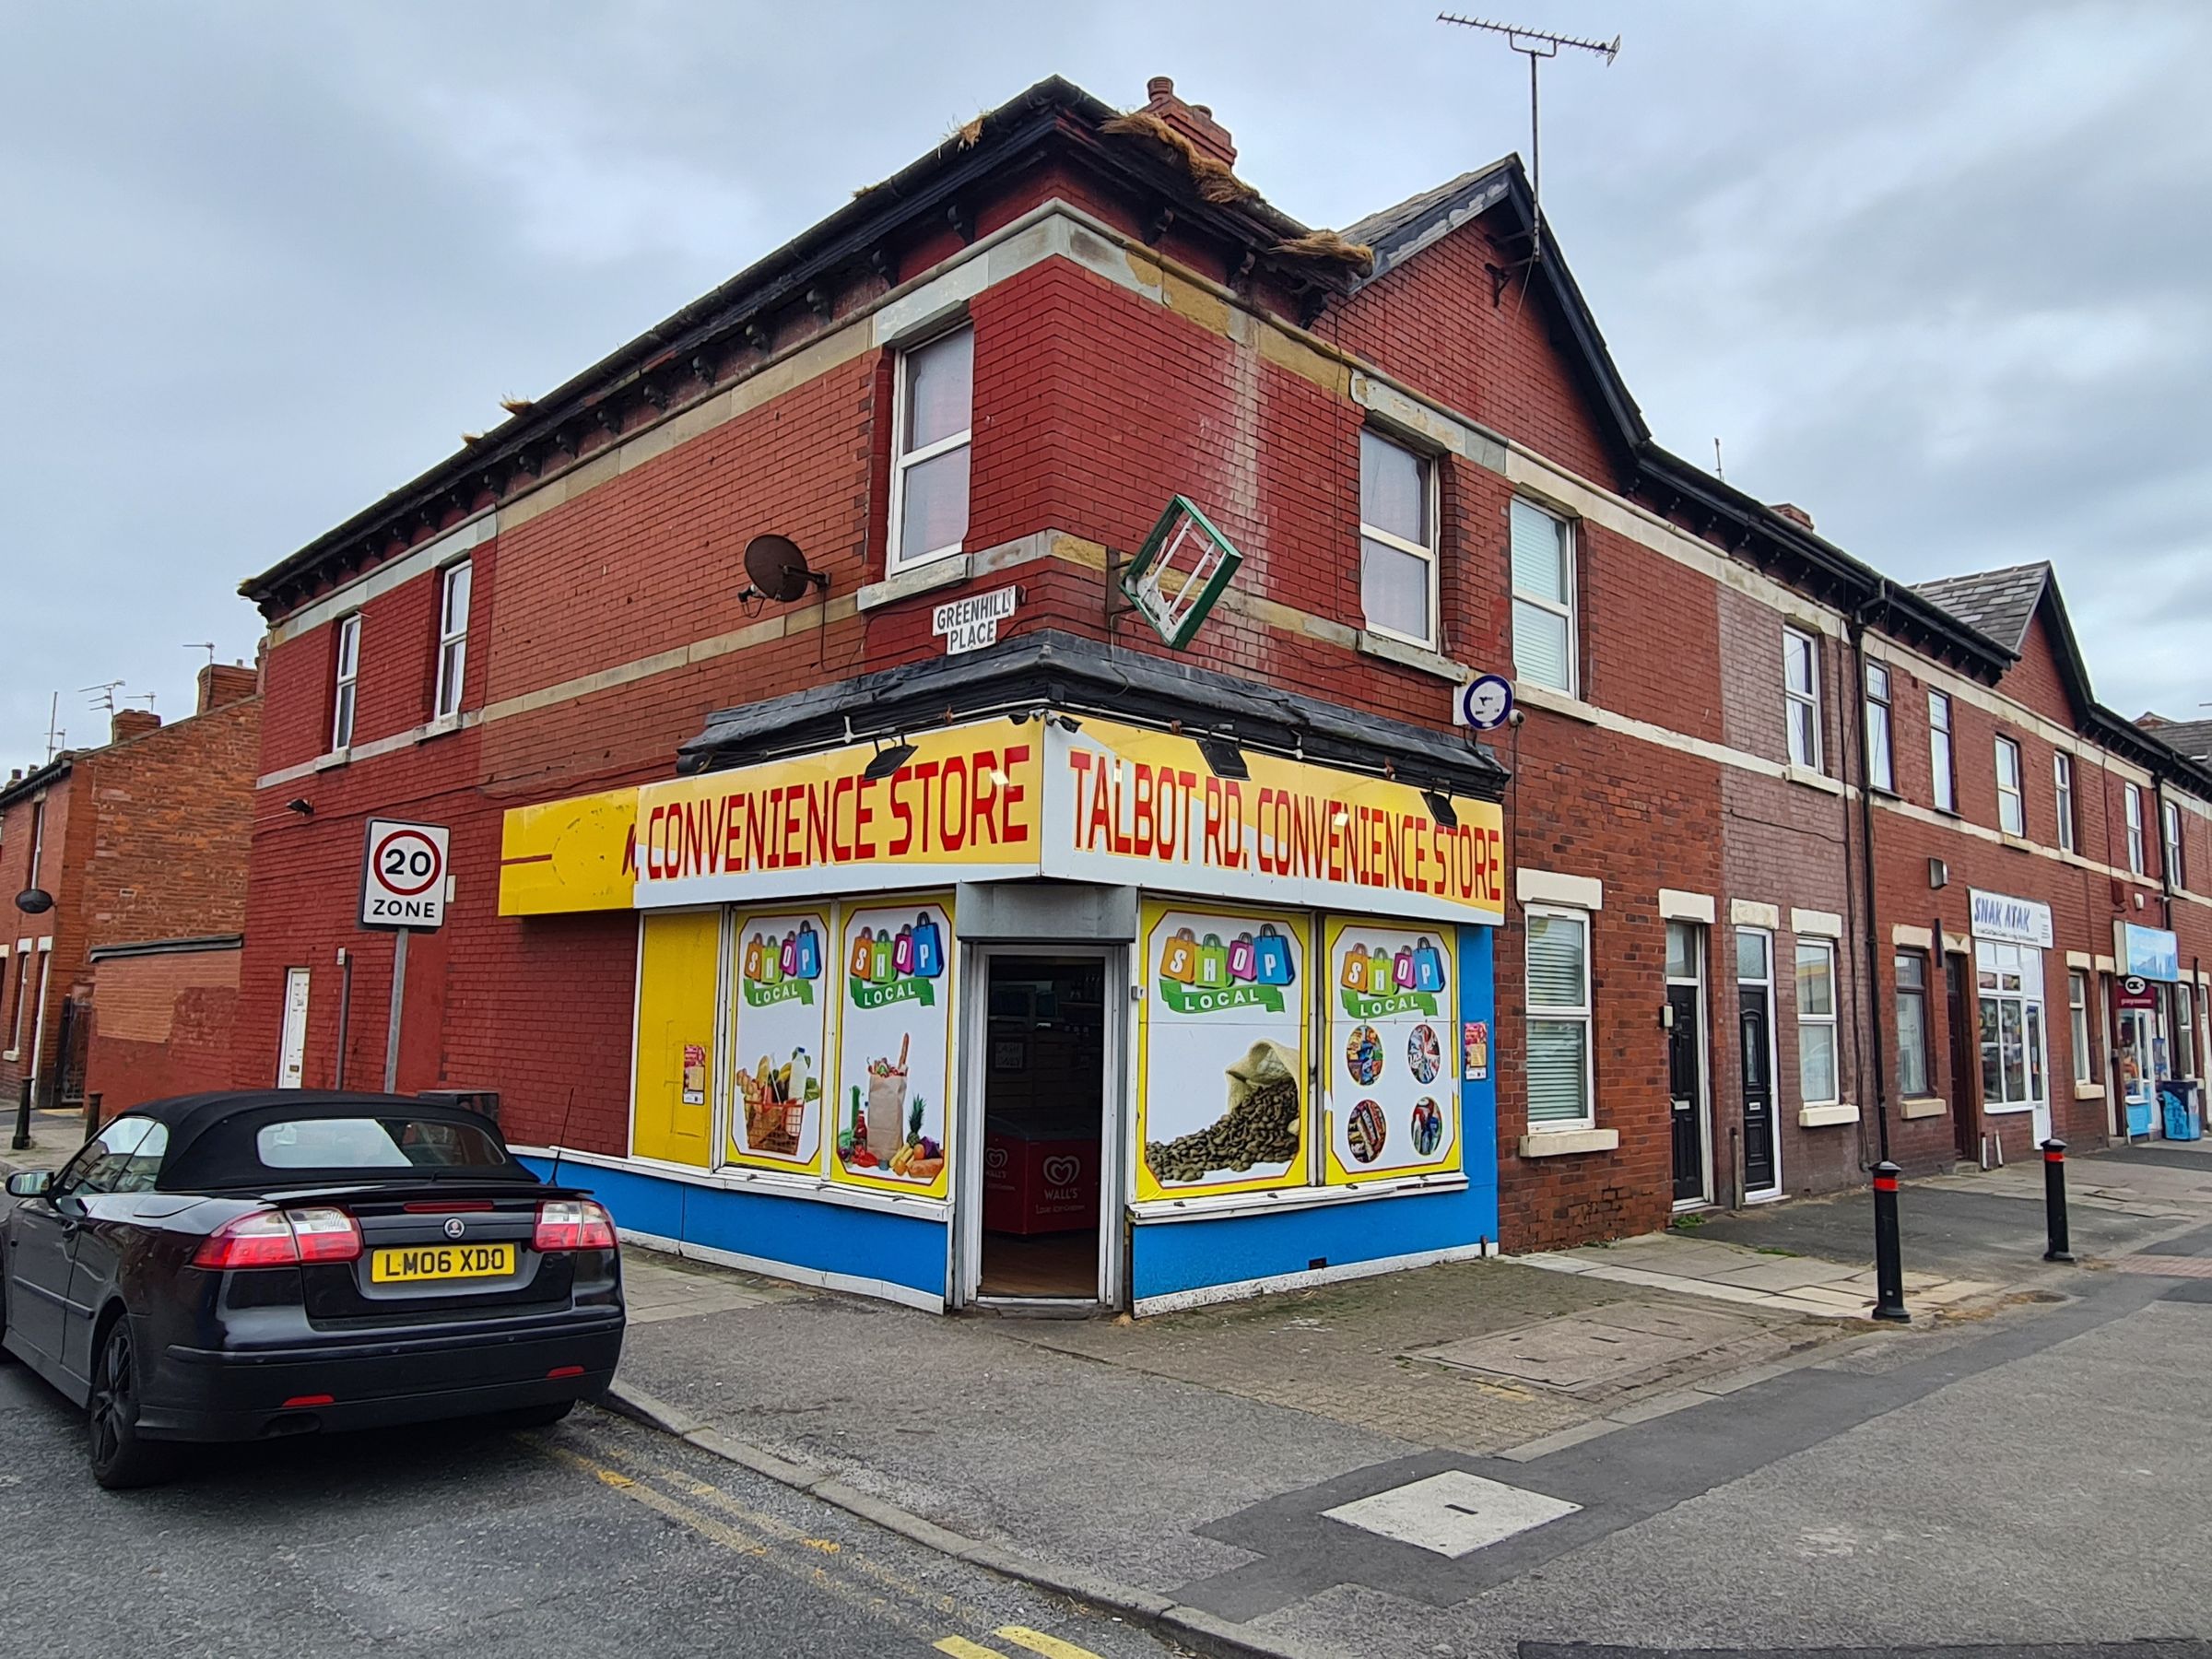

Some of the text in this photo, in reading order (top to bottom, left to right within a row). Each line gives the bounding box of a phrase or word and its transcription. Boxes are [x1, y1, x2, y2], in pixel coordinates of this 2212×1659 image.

[936, 592, 1010, 630] GREENHILL
[950, 620, 994, 651] PLACE
[647, 775, 877, 880] CONVENIENCE
[888, 745, 1030, 856] STORE
[1070, 751, 1500, 901] TALBOT RD. CONVENIENCE STORE
[384, 848, 431, 877] 20
[372, 900, 436, 918] ZONE
[1974, 897, 2002, 928] SNAK
[2005, 903, 2030, 933] ATAK
[748, 938, 810, 983] SHOP
[855, 940, 929, 978] SHOP
[1170, 947, 1276, 982] SHOP
[1348, 958, 1430, 992] SHOP
[755, 982, 798, 1005] LOCAL
[864, 982, 916, 1006] LOCAL
[1184, 988, 1260, 1011] LOCAL
[1359, 996, 1419, 1017] LOCAL
[1043, 1187, 1079, 1201] WALL'S
[385, 1248, 504, 1277] LM06 XDO
